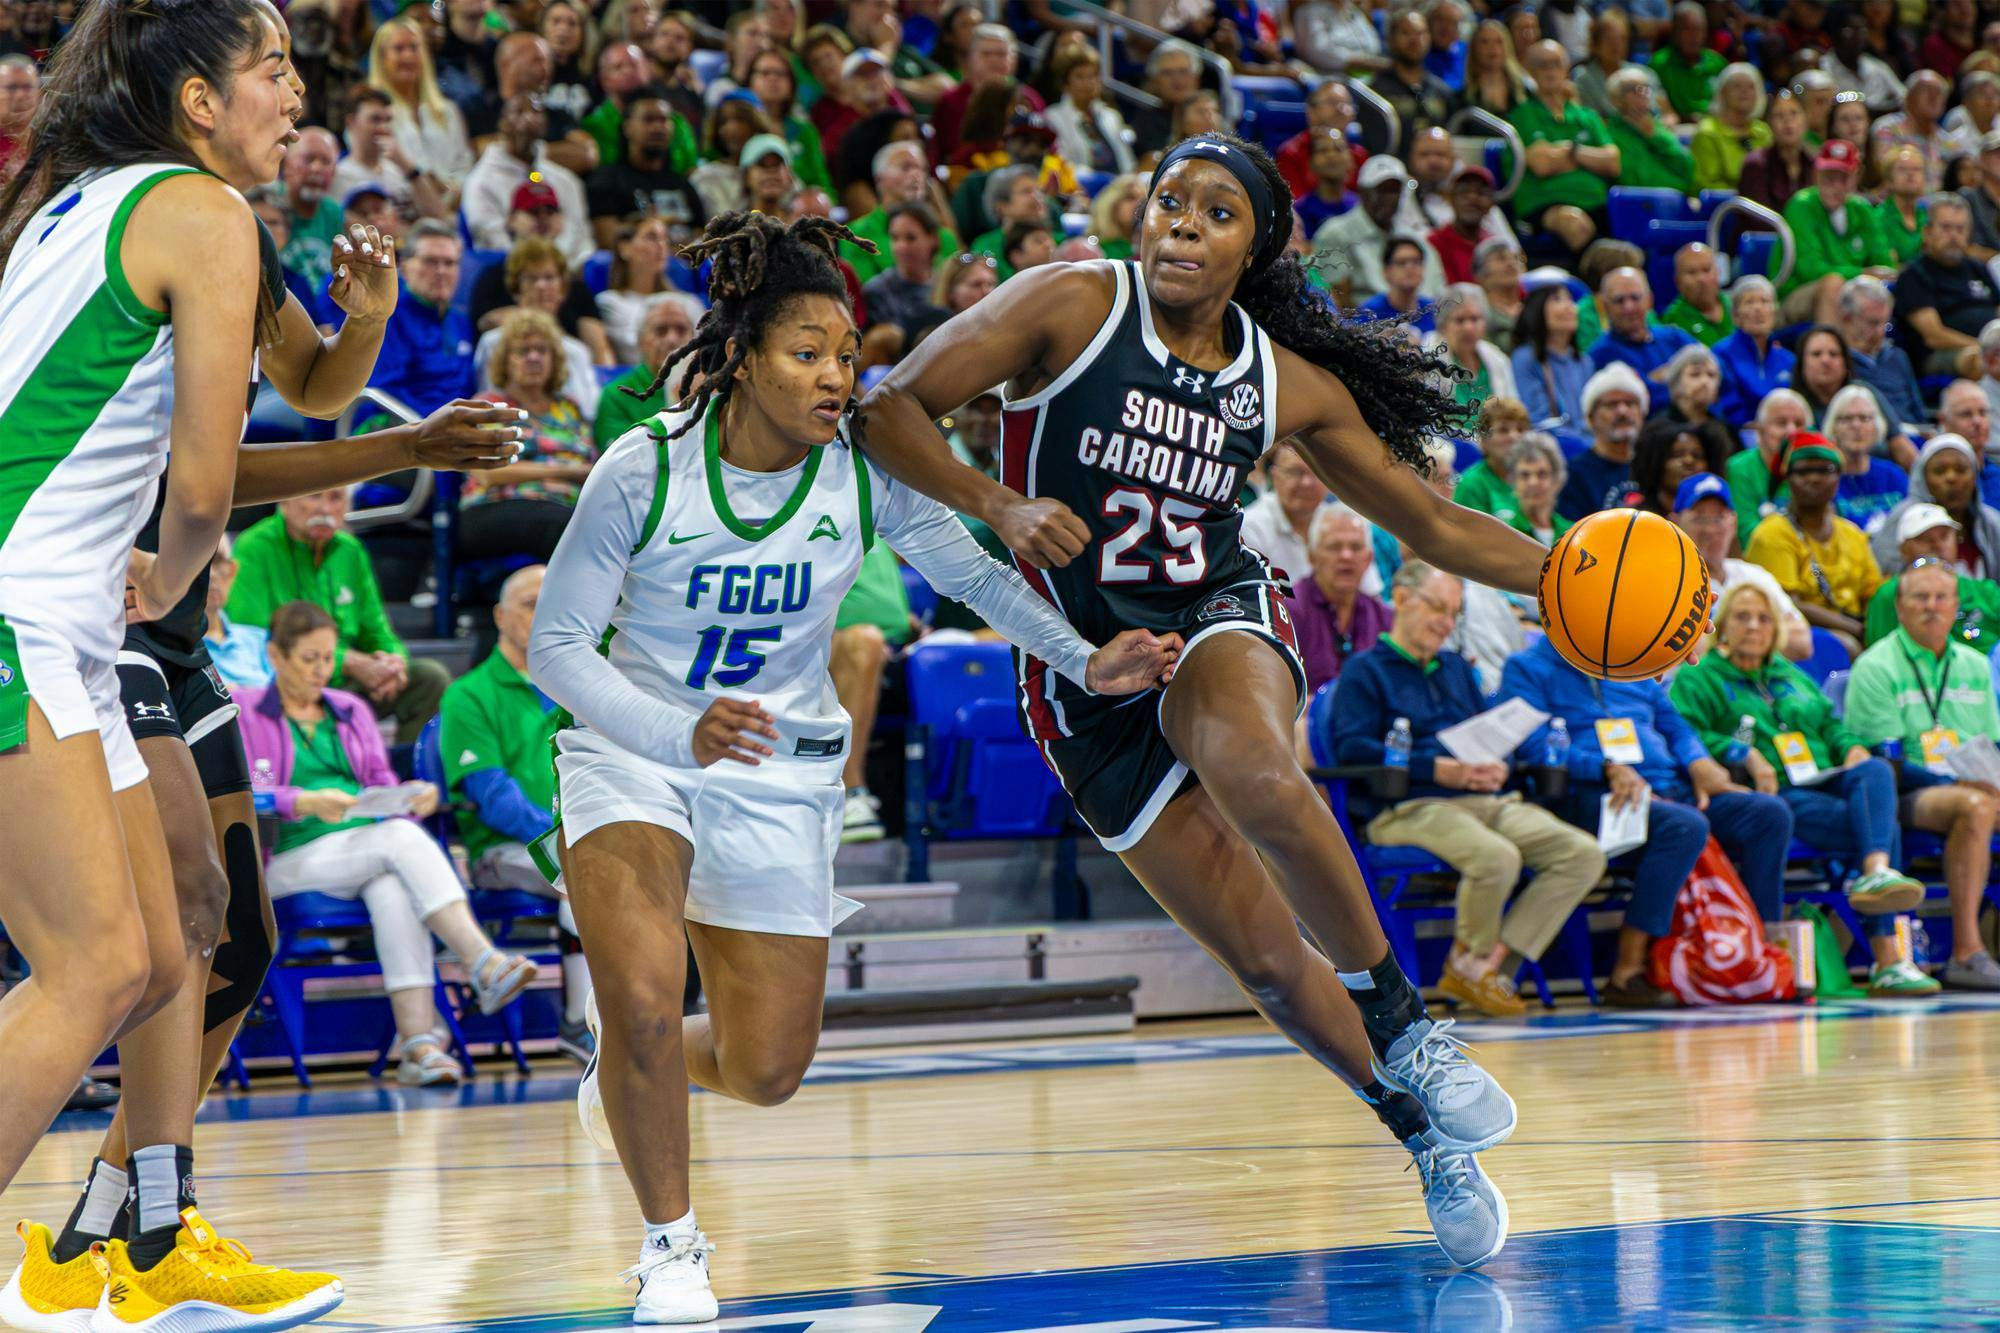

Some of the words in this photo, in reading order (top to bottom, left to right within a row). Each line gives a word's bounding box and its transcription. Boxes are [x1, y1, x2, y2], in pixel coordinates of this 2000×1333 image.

[1121, 388, 1226, 457] SOUTH
[1220, 405, 1255, 429] GRADUATE
[1230, 383, 1260, 418] SEC
[1077, 426, 1237, 503] CAROLINA
[1096, 484, 1212, 584] 25
[685, 561, 812, 614] FGCU
[685, 624, 783, 690] 15
